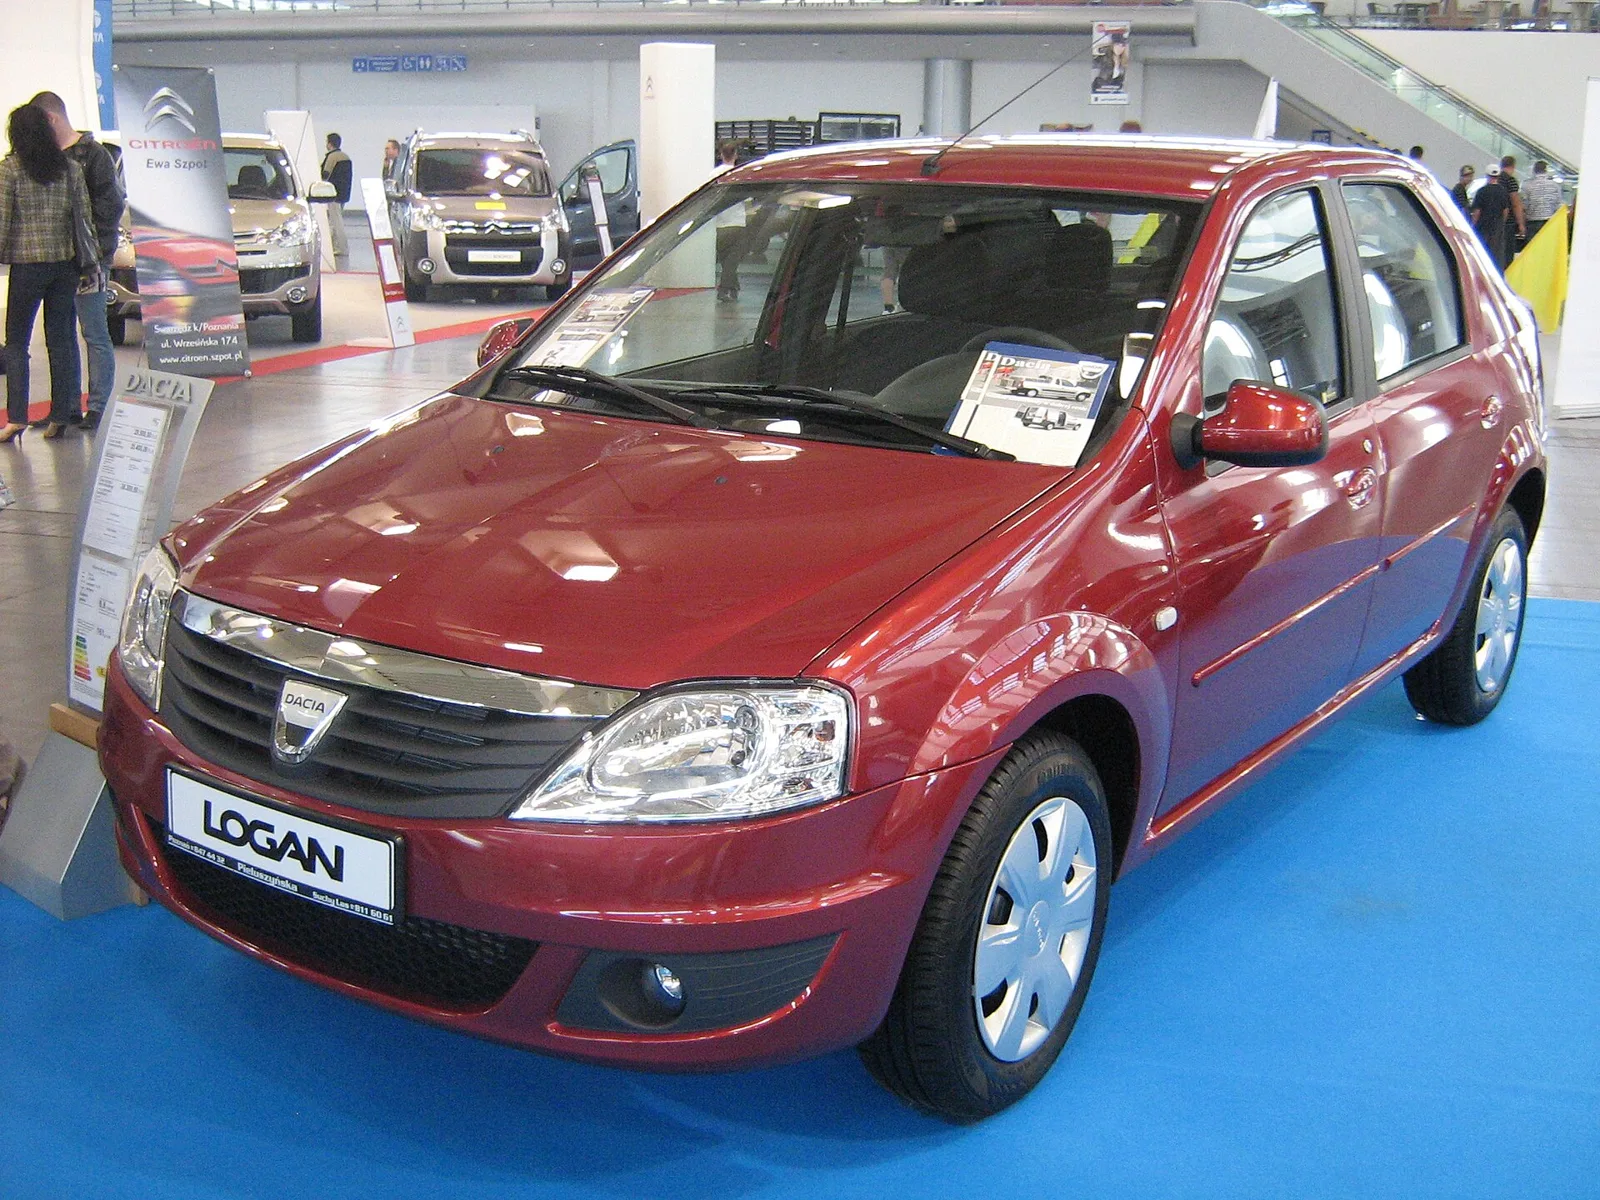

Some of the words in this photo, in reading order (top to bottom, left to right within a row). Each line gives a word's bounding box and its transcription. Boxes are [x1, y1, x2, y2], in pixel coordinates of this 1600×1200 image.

[146, 158, 171, 169] Ewa
[174, 158, 208, 171] Szpot
[161, 339, 172, 349] ul.
[174, 336, 219, 348] Wrzesińska
[221, 335, 238, 345] 174
[159, 350, 243, 364] www.citroen.szpot.pl
[125, 374, 192, 403] DACIA
[284, 693, 325, 714] DACIA
[203, 799, 344, 882] LOGAN
[370, 909, 382, 919] 60
[383, 913, 393, 922] 61
